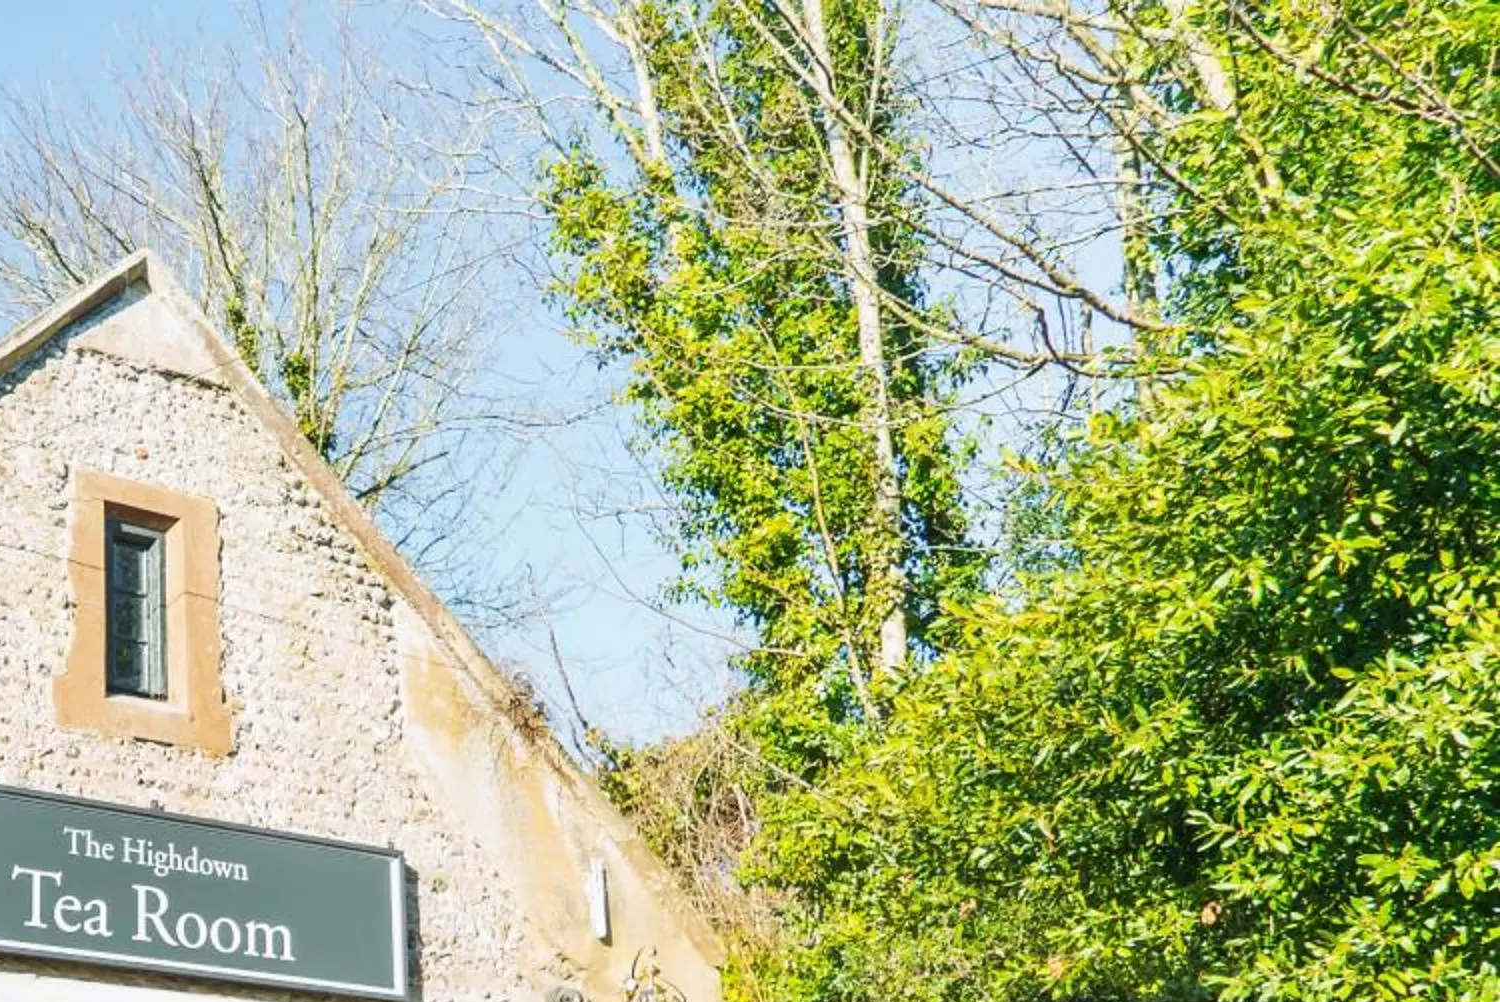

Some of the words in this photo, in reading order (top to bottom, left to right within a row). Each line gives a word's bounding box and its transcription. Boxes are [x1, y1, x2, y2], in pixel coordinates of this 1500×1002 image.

[63, 826, 115, 862] The
[123, 837, 249, 881] Highdown
[11, 865, 113, 937] Tea
[131, 884, 296, 961] Room
